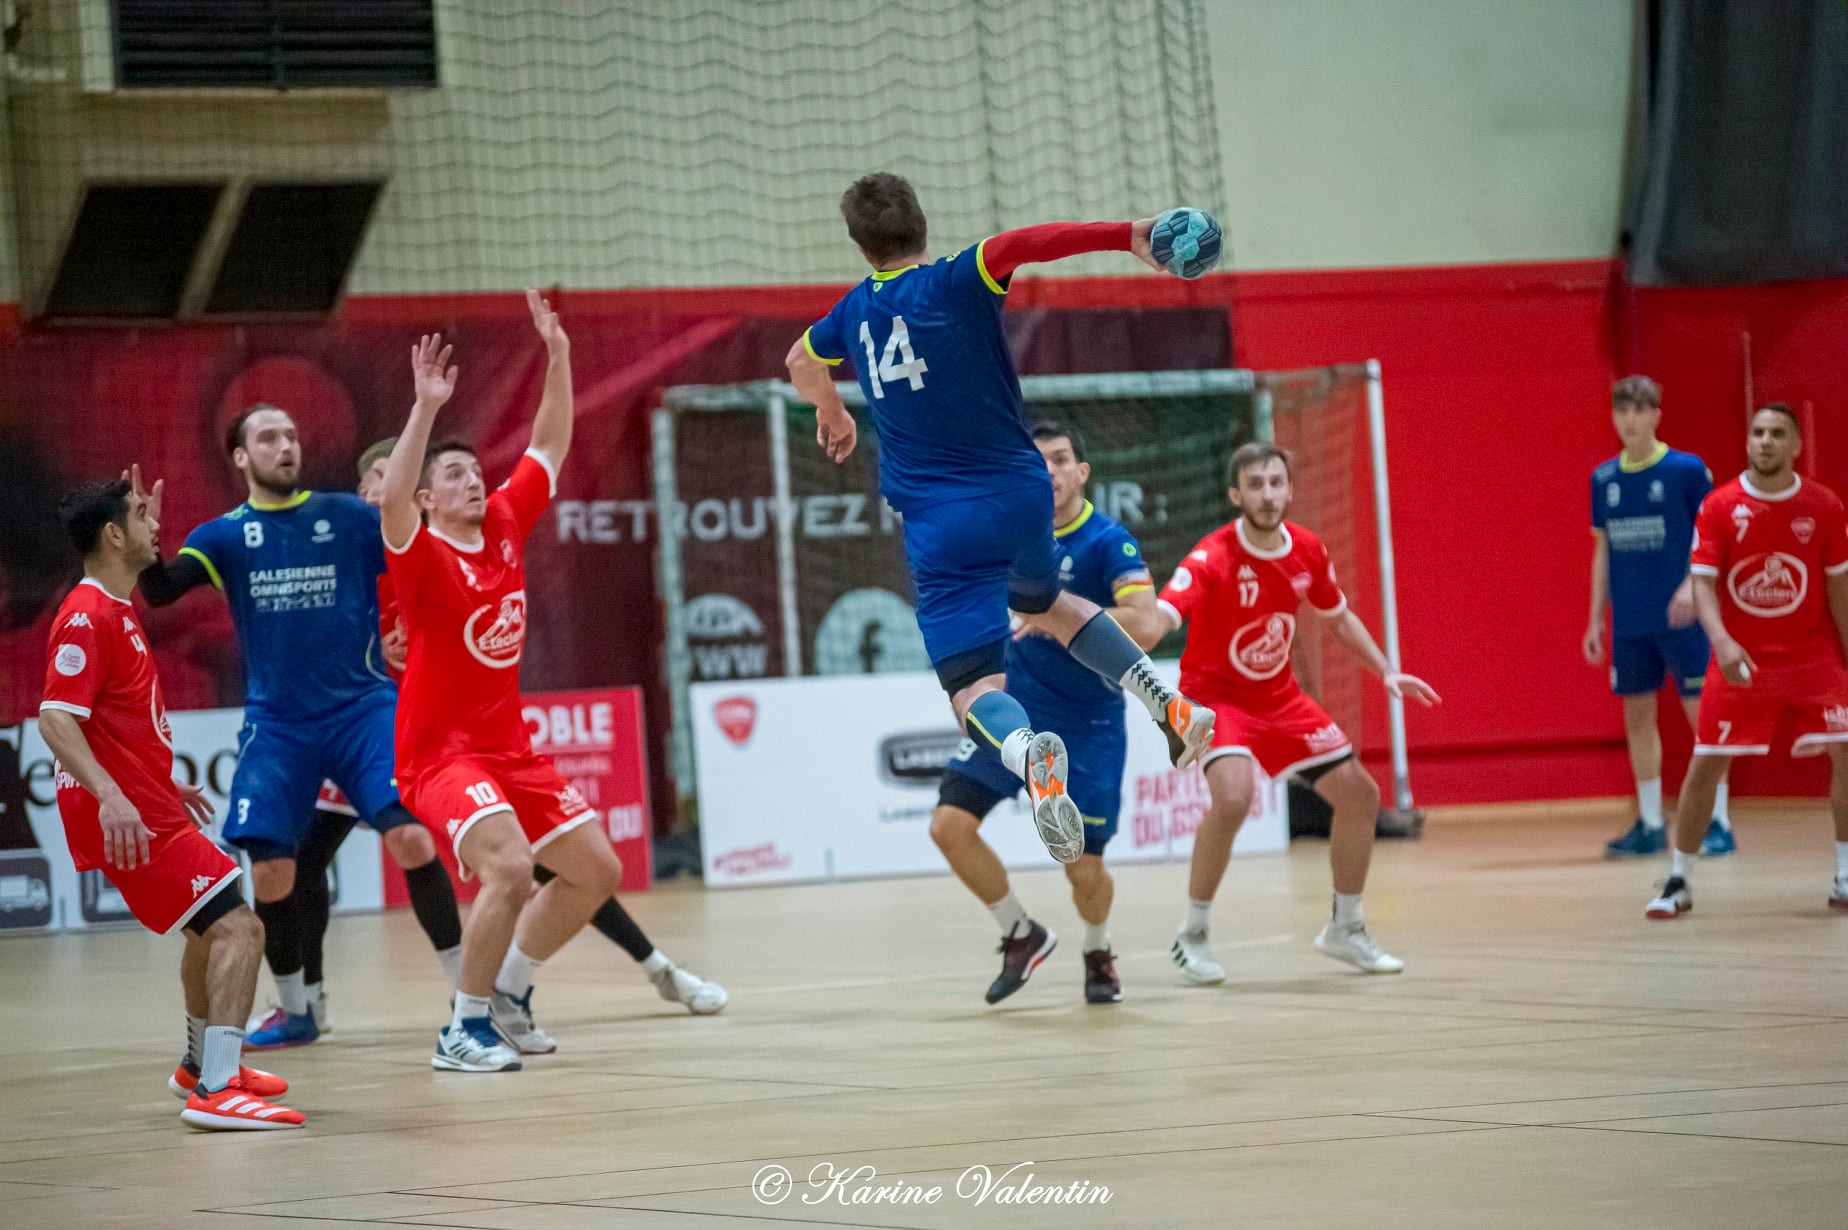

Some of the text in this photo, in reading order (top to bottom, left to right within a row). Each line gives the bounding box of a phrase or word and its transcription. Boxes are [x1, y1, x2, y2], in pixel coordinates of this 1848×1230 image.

[859, 316, 928, 399] 14
[243, 520, 264, 549] 8
[1735, 518, 1749, 543] 7
[1238, 580, 1259, 607] 17
[521, 703, 613, 749] OBLE
[1718, 720, 1732, 745] 7
[465, 780, 498, 807] 10
